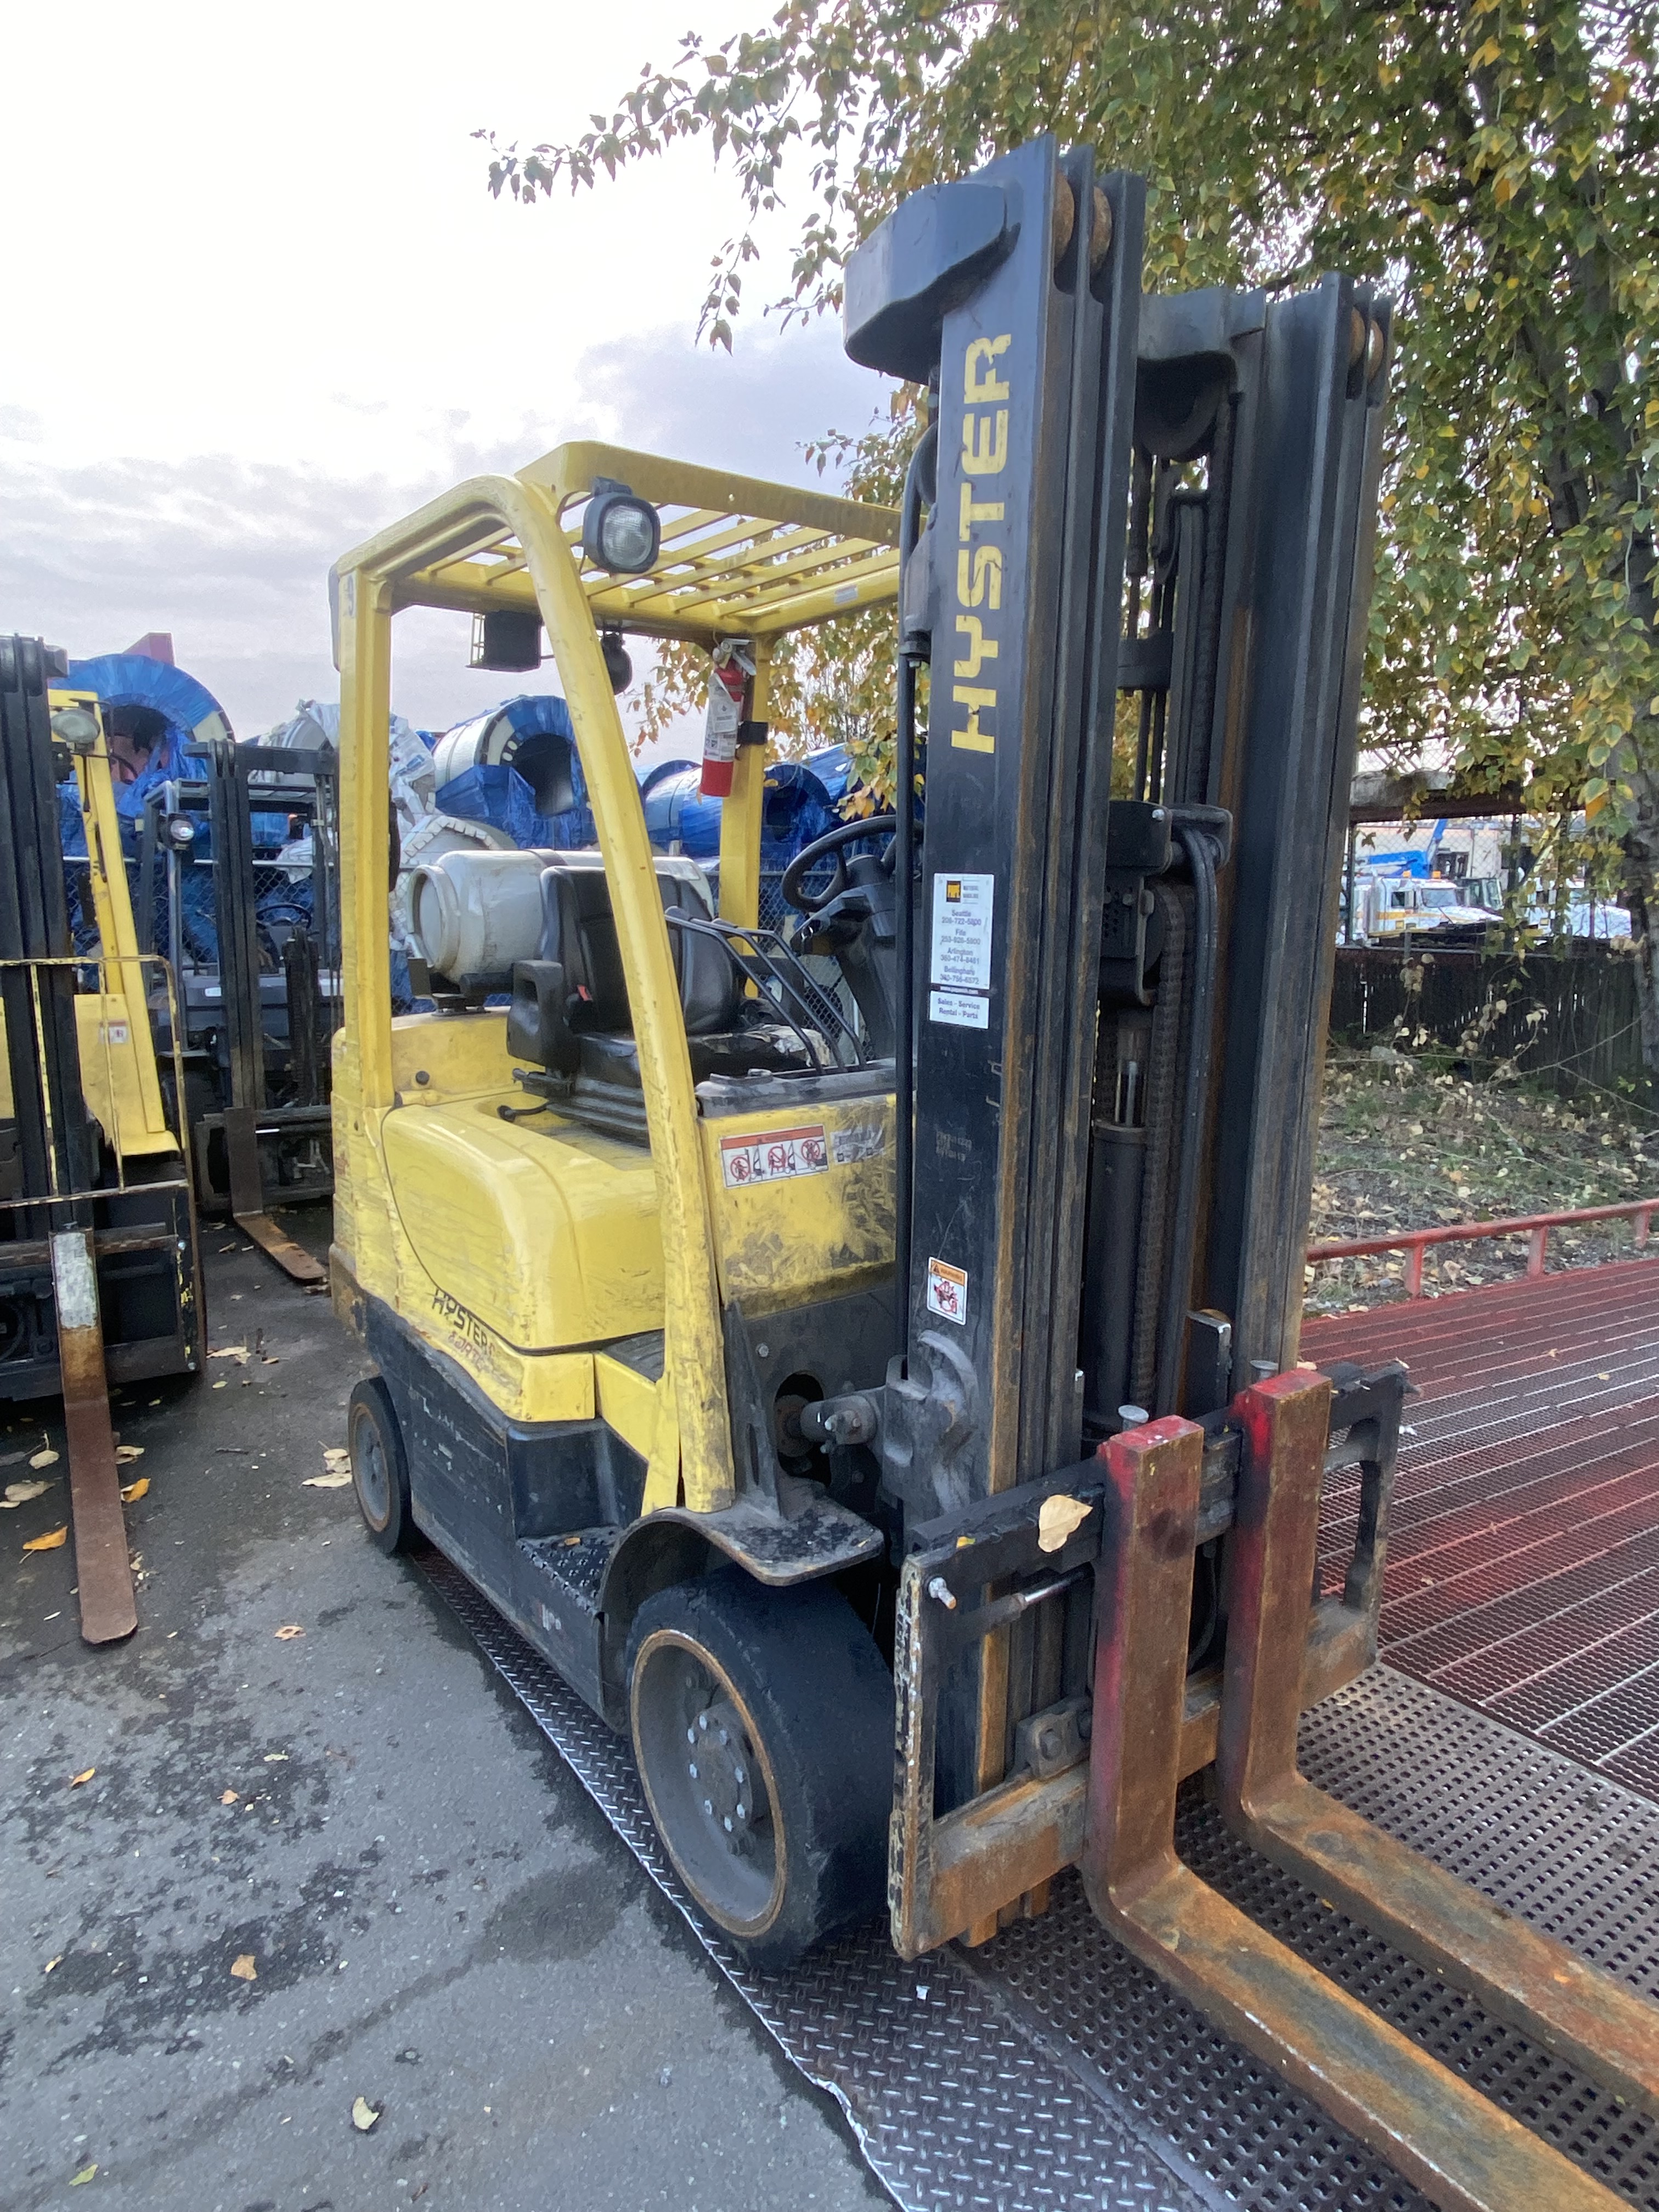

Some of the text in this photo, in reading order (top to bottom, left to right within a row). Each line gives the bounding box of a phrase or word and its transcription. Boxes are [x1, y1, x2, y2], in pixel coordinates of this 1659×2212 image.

[950, 333, 1012, 754] HYSTER
[947, 947, 973, 956] Arlington
[944, 966, 975, 975] Bellingham
[938, 997, 952, 1006] Sales
[958, 1000, 980, 1009] Service
[939, 1007, 957, 1015] Rental
[962, 1011, 978, 1019] Parts
